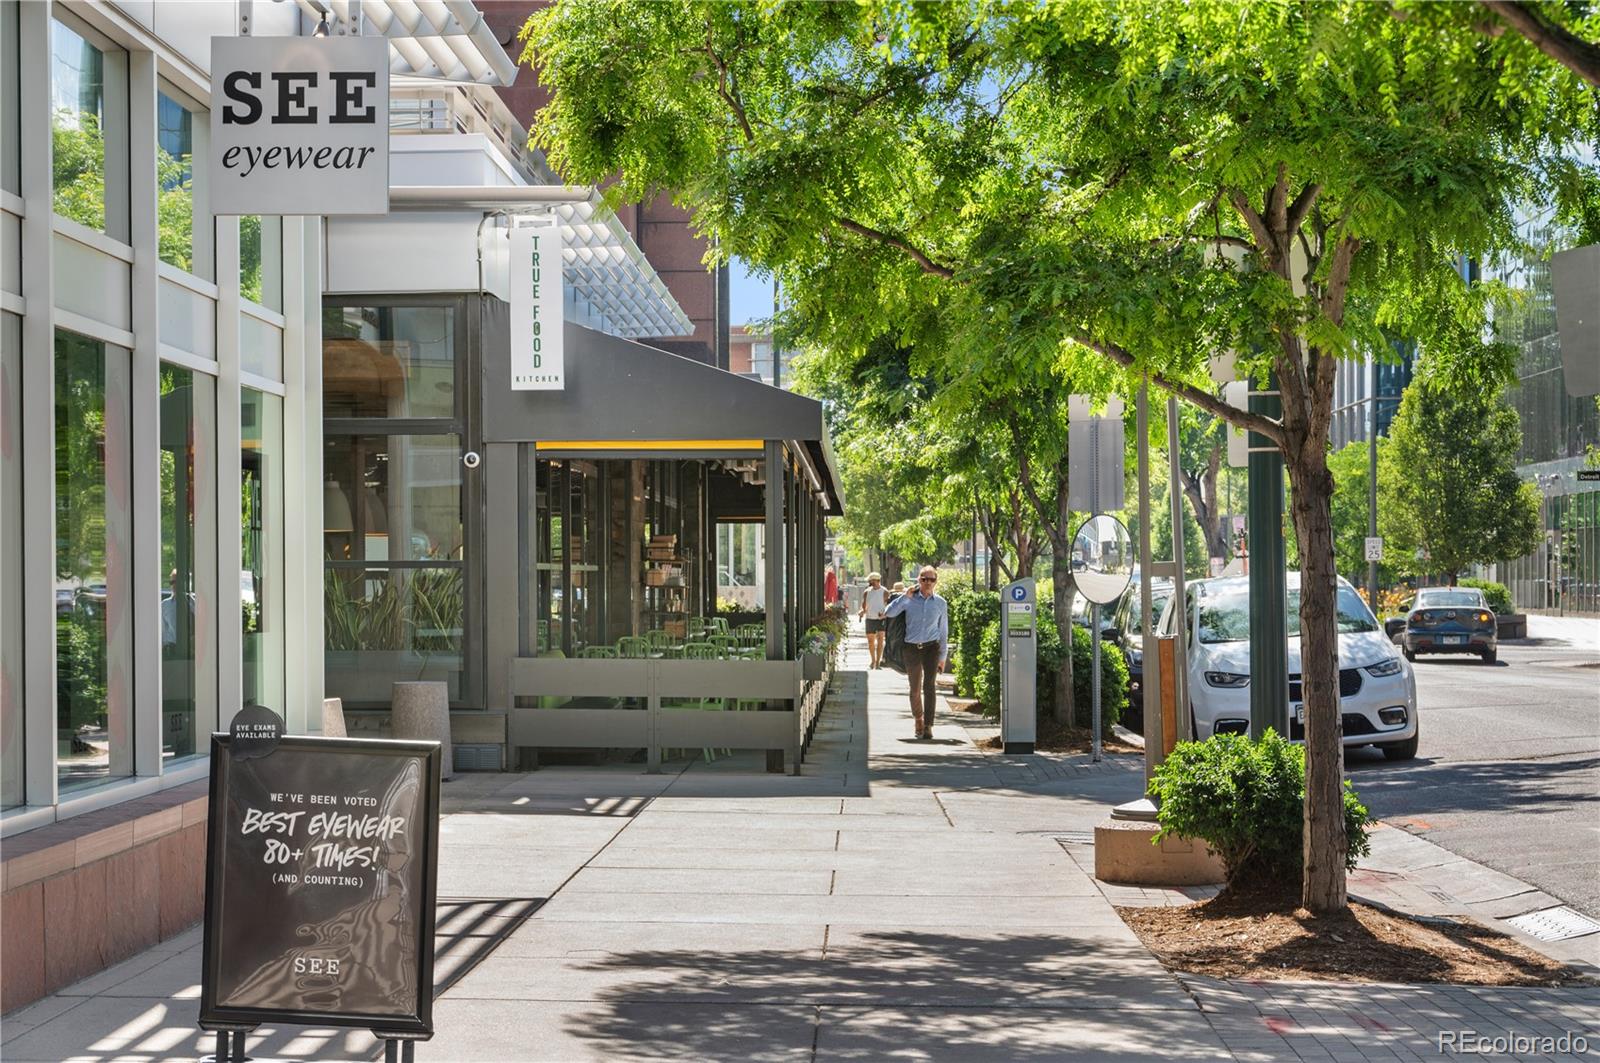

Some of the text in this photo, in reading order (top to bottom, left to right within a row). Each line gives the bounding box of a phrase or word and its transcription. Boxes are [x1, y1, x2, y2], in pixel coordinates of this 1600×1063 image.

[222, 71, 376, 125] SEE
[222, 146, 375, 178] eyewear
[532, 236, 542, 369] TRUE FOOD
[515, 375, 559, 383] KITCHEN
[1368, 550, 1380, 559] 25
[270, 793, 377, 807] WE'VE BEEN VOTED
[241, 808, 405, 841] BEST EYEWEAR
[263, 838, 380, 872] 80+ TIMES!
[272, 873, 364, 888] (AND COUNTING)
[294, 957, 340, 975] SEE
